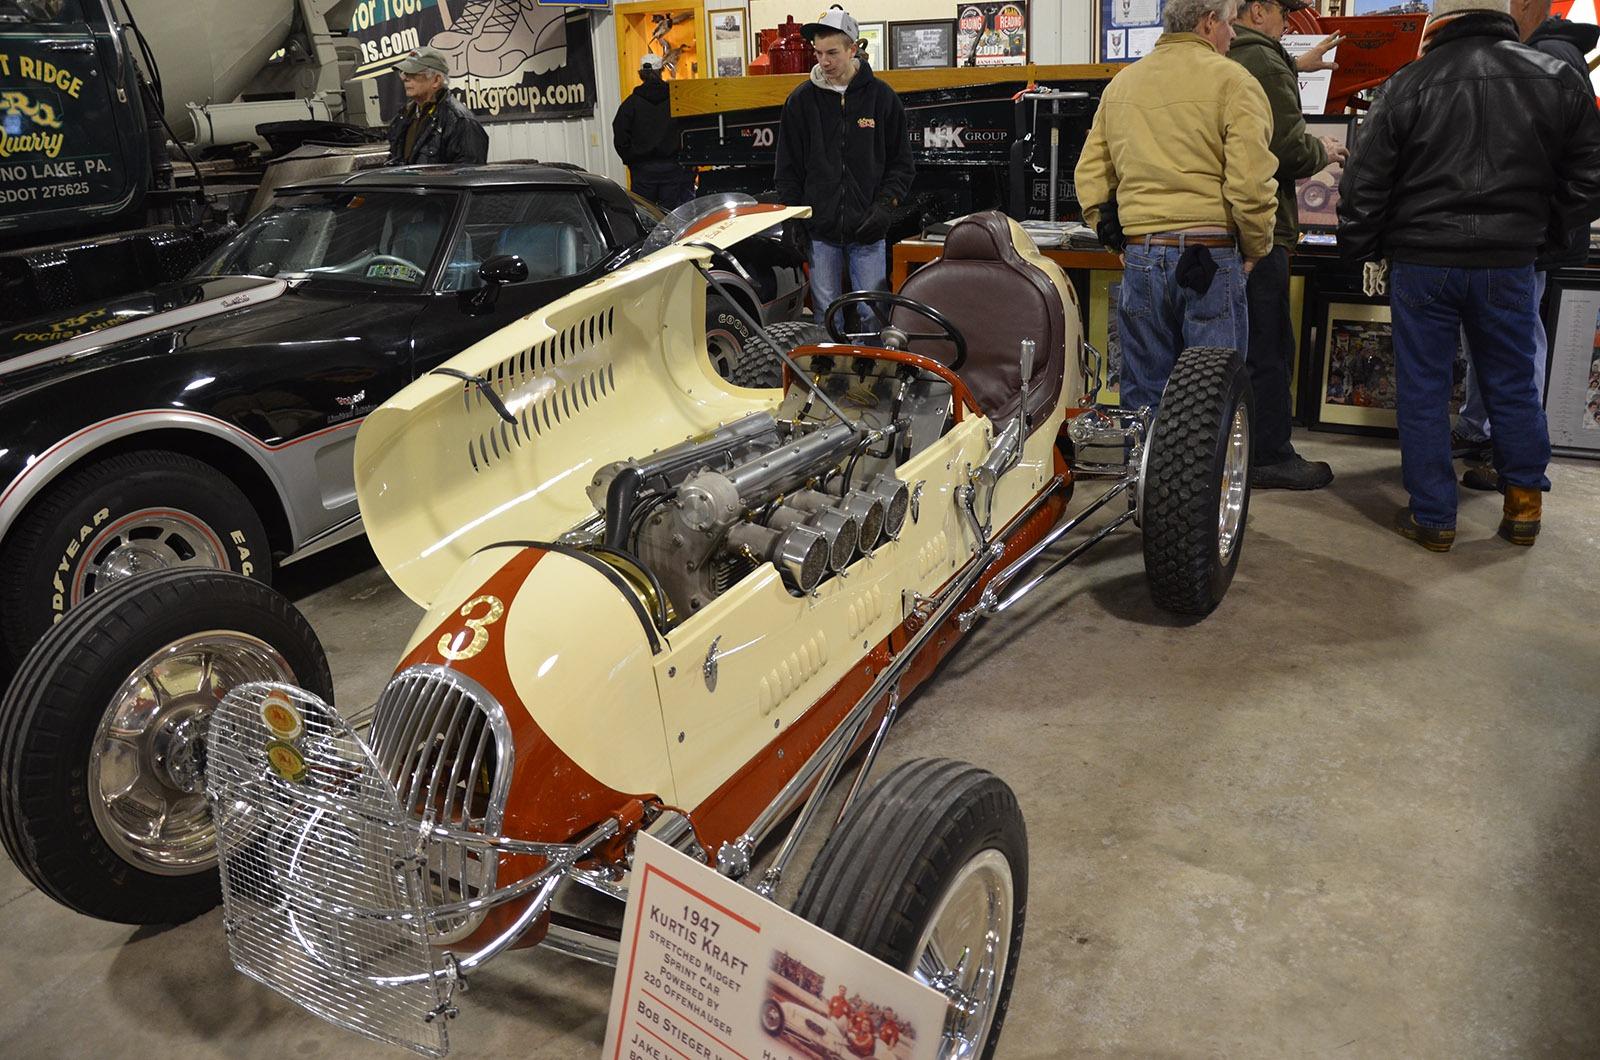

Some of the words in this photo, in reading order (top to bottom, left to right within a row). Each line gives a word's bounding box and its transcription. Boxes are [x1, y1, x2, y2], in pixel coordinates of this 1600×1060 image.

[352, 0, 376, 32] for
[999, 15, 1022, 29] READING
[1401, 22, 1416, 32] 25
[20, 56, 84, 98] RIDGE
[753, 128, 774, 146] 20
[965, 132, 1007, 141] GROUP
[32, 161, 82, 179] LAKE,
[85, 159, 112, 174] PA.
[42, 182, 90, 198] 275625
[718, 313, 749, 338] GOOD
[437, 595, 504, 660] 3
[683, 905, 720, 937] 1947
[650, 905, 697, 945] KURTIS
[701, 936, 748, 975] KRAFT
[649, 930, 701, 968] STRETCHED
[704, 962, 741, 993] MIDGET
[663, 953, 697, 984] SPRINT
[700, 977, 720, 996] CAR
[643, 971, 661, 988] 220
[664, 985, 732, 1036] OFFENHAUSER
[660, 968, 704, 1002] POWERED
[707, 998, 720, 1011] BY
[637, 1001, 660, 1024] BOB
[662, 1019, 711, 1060] STIEGER
[631, 1034, 660, 1060] JAKE
